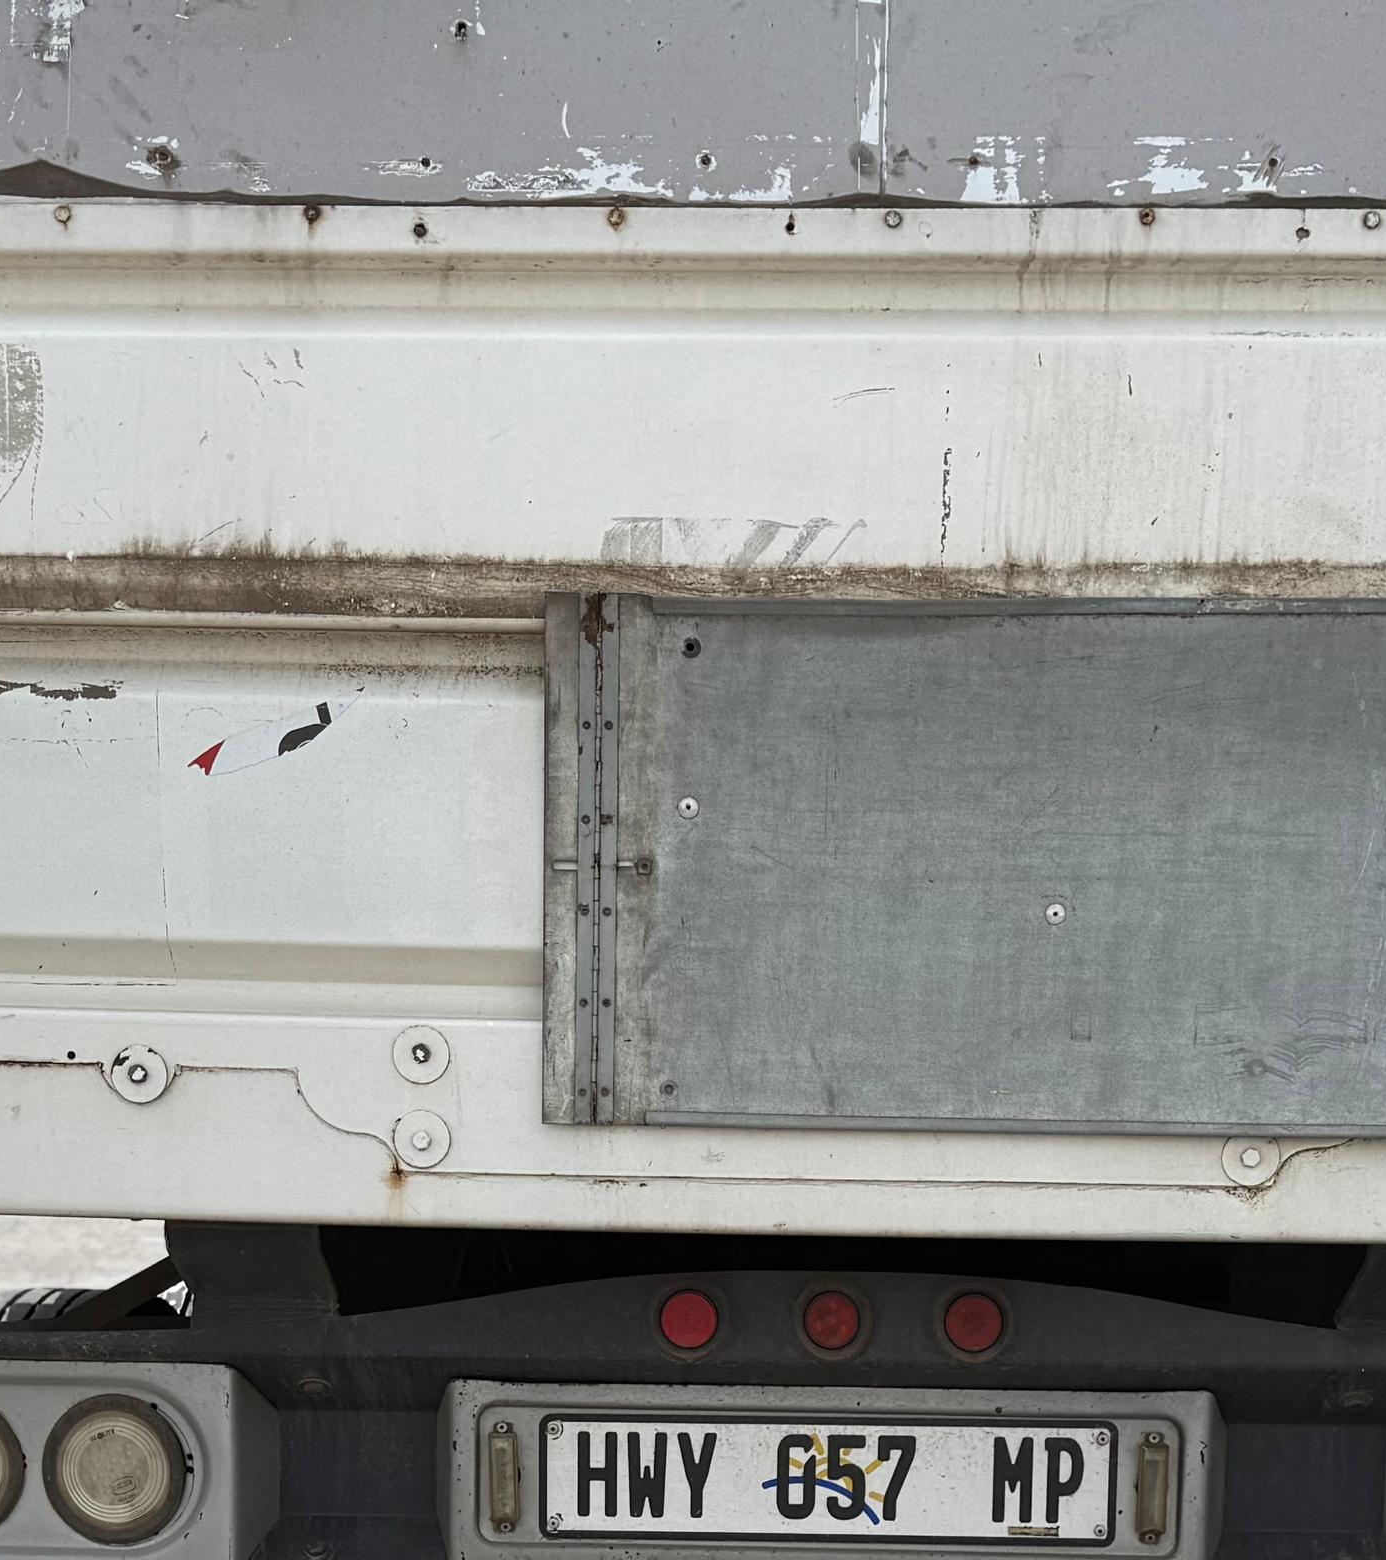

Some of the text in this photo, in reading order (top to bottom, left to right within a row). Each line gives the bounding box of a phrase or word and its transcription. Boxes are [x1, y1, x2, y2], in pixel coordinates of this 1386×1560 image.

[576, 1431, 1084, 1523] HWY 057 MP
